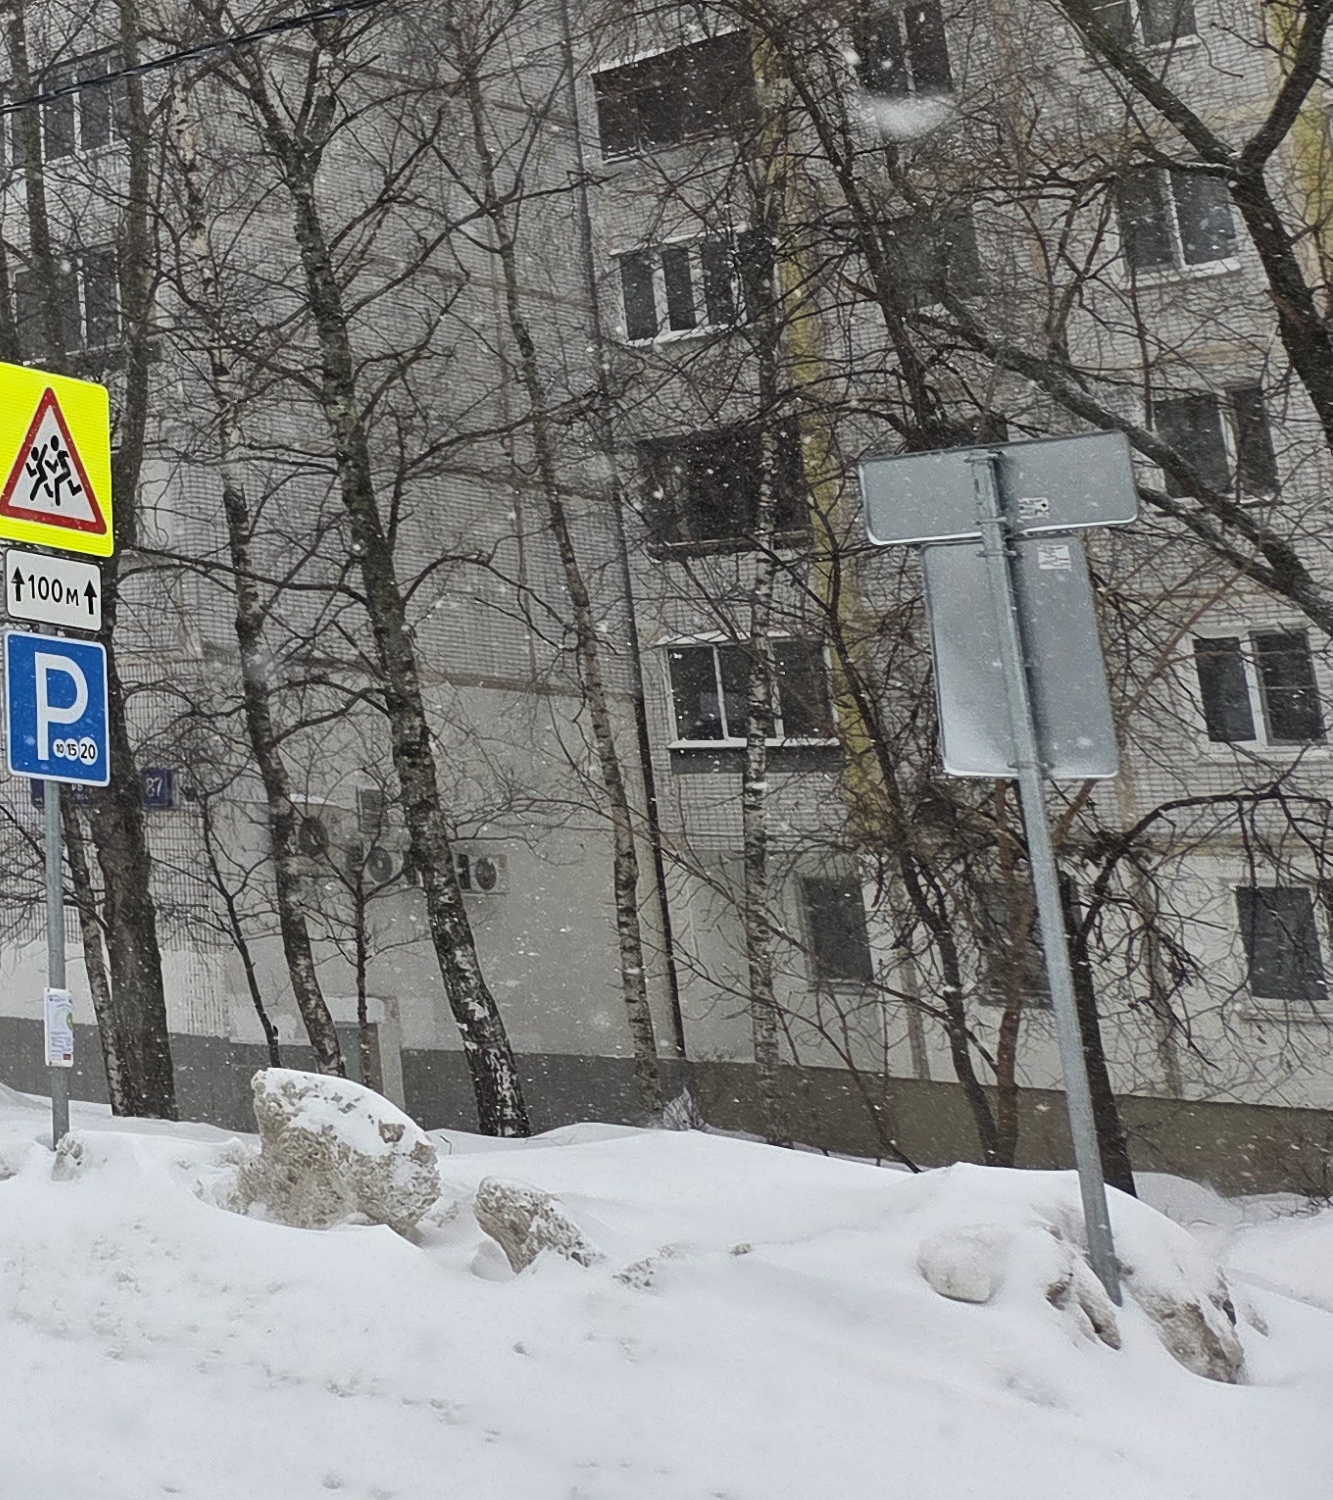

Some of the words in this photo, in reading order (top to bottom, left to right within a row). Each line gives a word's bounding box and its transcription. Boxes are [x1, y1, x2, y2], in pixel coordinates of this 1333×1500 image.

[27, 573, 80, 608] 100м
[34, 651, 89, 761] P
[66, 743, 78, 757] 15
[80, 743, 96, 760] 20
